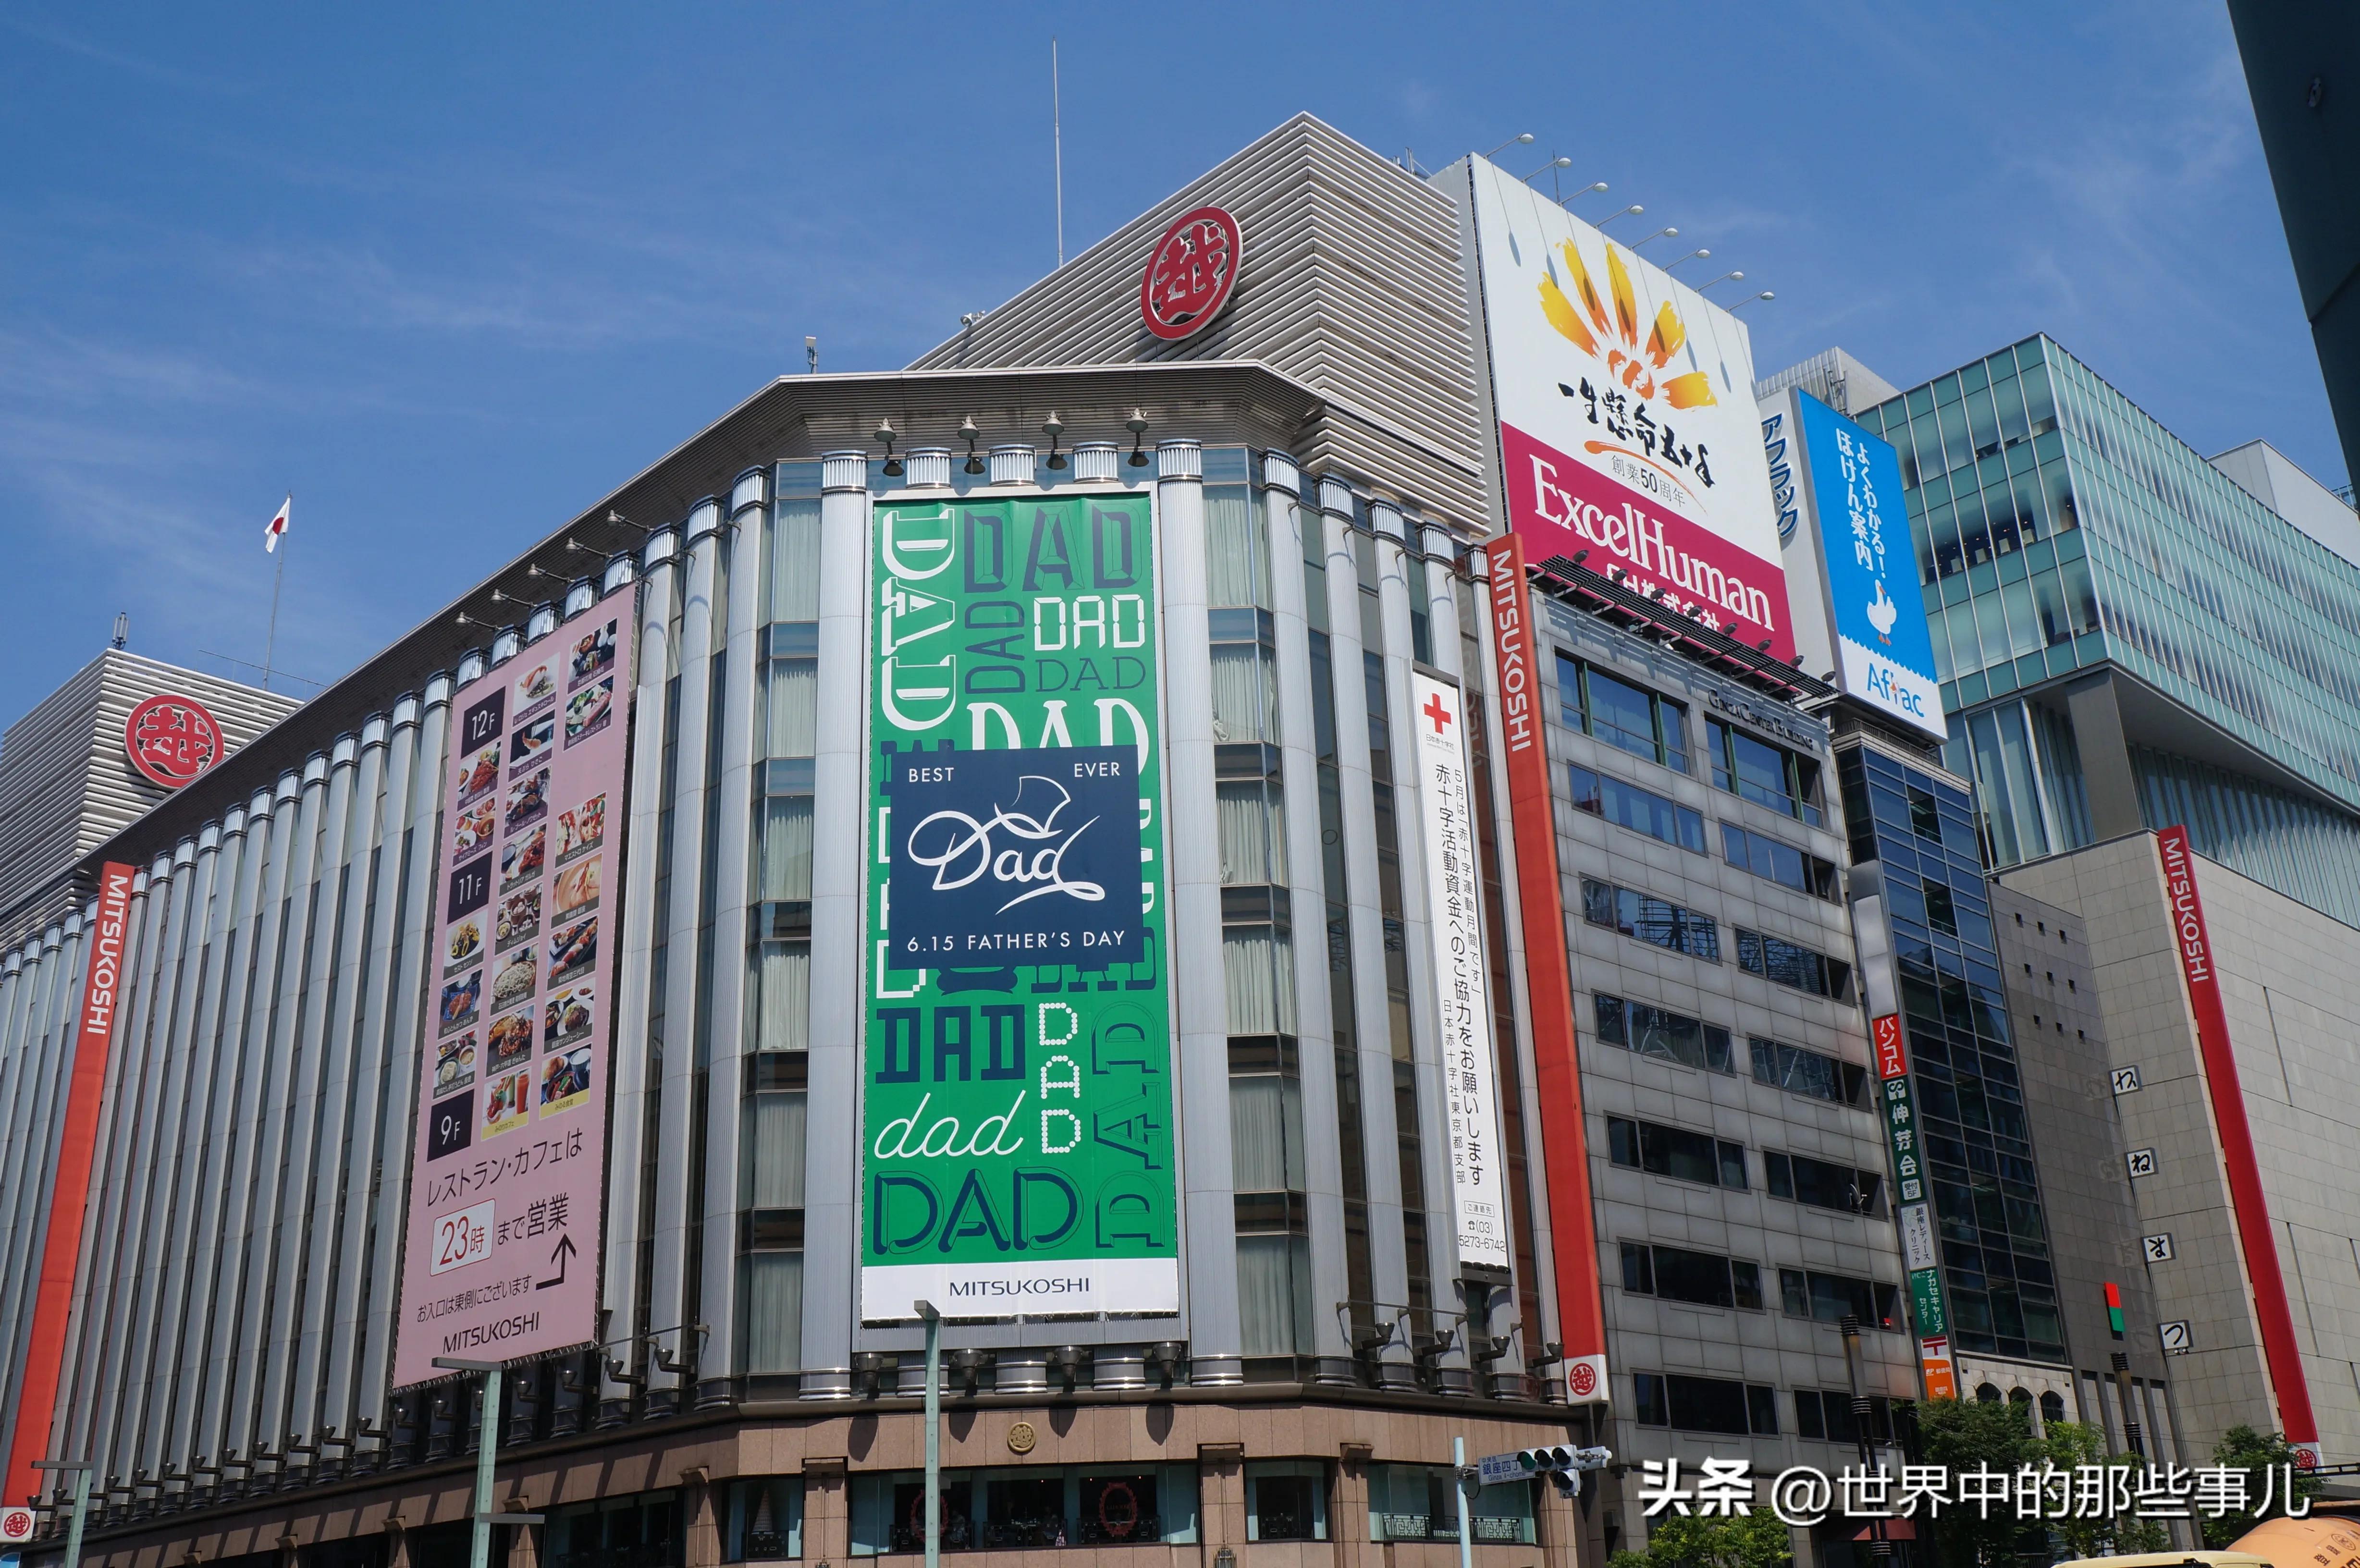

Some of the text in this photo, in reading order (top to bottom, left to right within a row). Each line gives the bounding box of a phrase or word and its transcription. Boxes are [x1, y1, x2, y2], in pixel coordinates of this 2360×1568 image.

[1611, 455, 1685, 507] 創業50周年
[1761, 413, 1798, 537] アフラック
[1836, 428, 1873, 571] ほけん案内
[964, 503, 1142, 593] DAD
[1529, 454, 1774, 631] ExcelHuman
[882, 508, 956, 731] DAD
[965, 600, 1025, 694] DAD
[1033, 594, 1145, 651] DAD
[1035, 656, 1146, 692] DAD
[1493, 549, 1531, 752] MITSUKOSHI
[471, 709, 495, 740] 12F
[909, 761, 1120, 783] BEST EVER
[459, 874, 482, 904] 11F
[908, 810, 1105, 915] Dad
[2164, 837, 2209, 982] MITSUKOSHI
[87, 874, 128, 1034] MITSUKOSHI
[907, 930, 1125, 952] 6.15 FATHER'S DAY
[1436, 763, 1483, 1186] 赤十字活動資金へのご協力をお願いします
[875, 1004, 1026, 1084] DAD
[1880, 1017, 1901, 1076] バンコム
[1039, 1002, 1081, 1153] DAD
[1444, 999, 1466, 1184] 日本赤十字社東京都支部
[441, 1115, 460, 1145] 9F
[874, 1090, 1026, 1159] dad
[1092, 1001, 1165, 1249] DAD
[1893, 1103, 1917, 1176] 伸芽会
[428, 1127, 583, 1207] レストラン・カフェは
[1904, 1182, 1918, 1191] 受付
[1908, 1189, 1917, 1198] 5F
[439, 1192, 569, 1266] 23時 まで営業
[873, 1166, 1084, 1255] DAD
[1468, 1203, 1492, 1214] ご連絡先
[1476, 1219, 1493, 1235] (03)
[1916, 1207, 1930, 1261] 銀座レディース
[1459, 1235, 1506, 1253] 5273-6742
[1910, 1229, 1920, 1264] クリニック
[417, 1274, 532, 1323] お入口は東側にございます
[949, 1277, 1090, 1297] MITSUKOSHI
[1919, 1297, 1928, 1325] センター
[1926, 1269, 1943, 1333] ナガセキャリア
[442, 1311, 540, 1354] MITSUKOSHI
[1483, 1459, 1519, 1475] 銀座四丁
